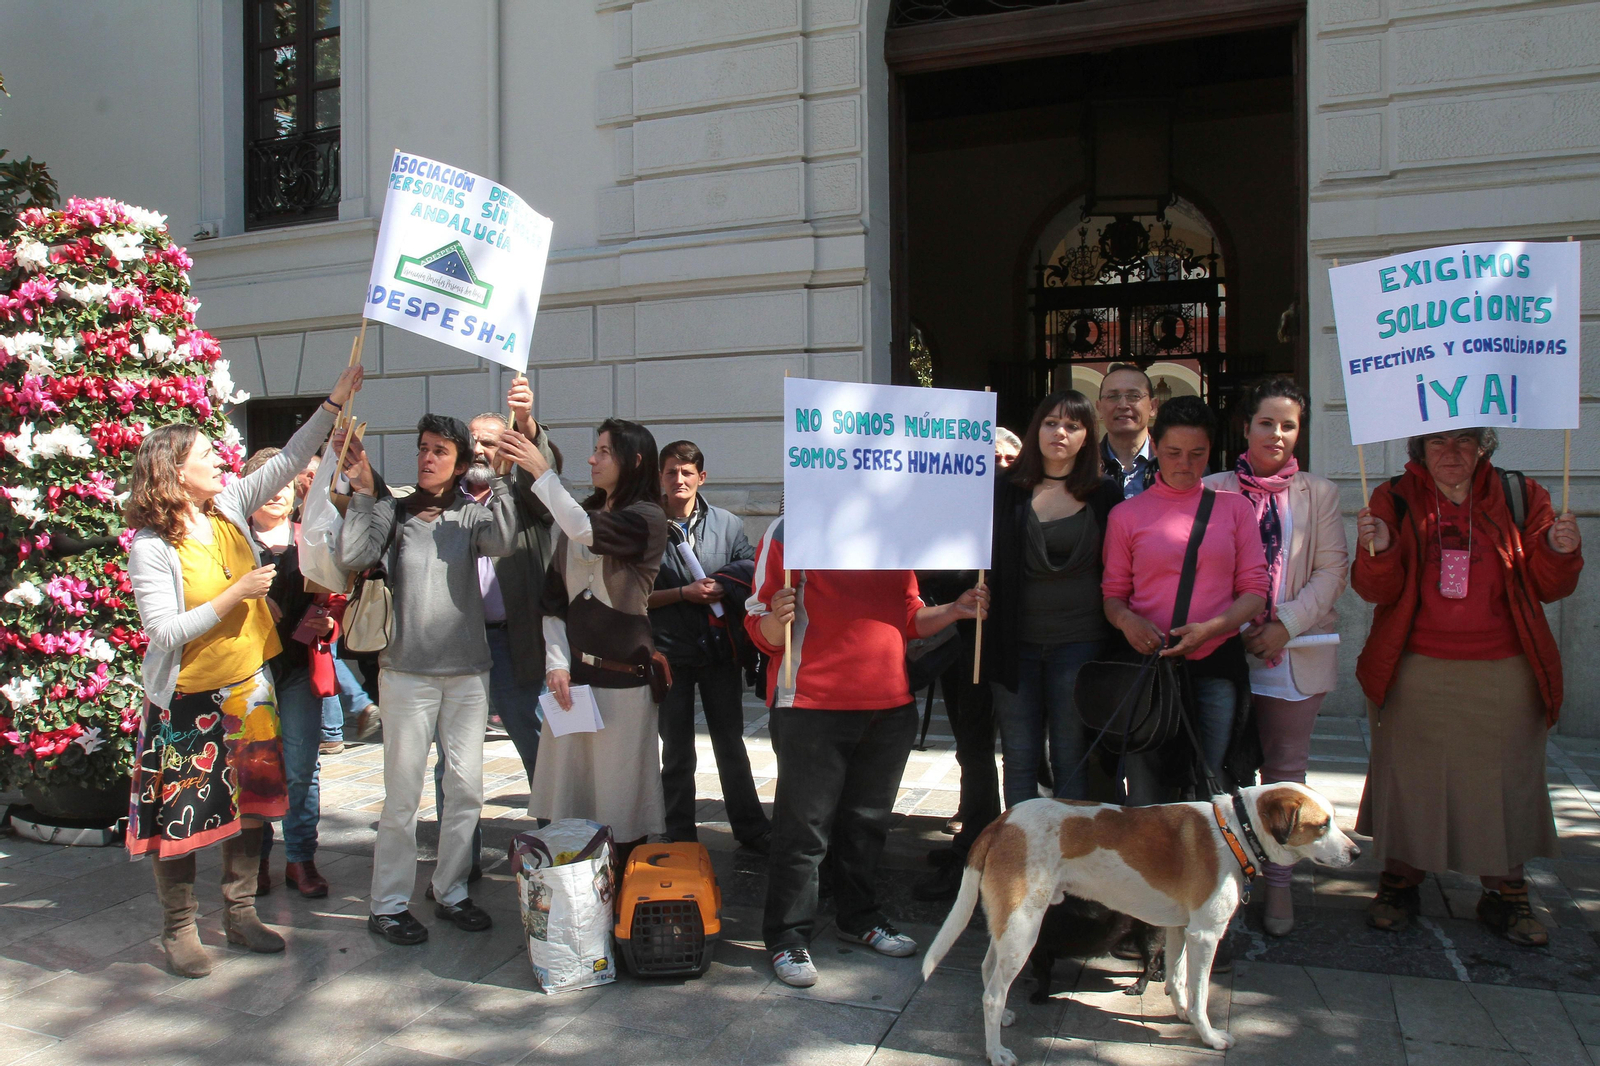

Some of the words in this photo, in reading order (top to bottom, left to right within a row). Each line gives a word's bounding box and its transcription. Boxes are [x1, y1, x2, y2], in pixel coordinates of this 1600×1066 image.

[389, 173, 465, 208] PERSONAS
[481, 202, 510, 226] SIN
[392, 155, 475, 193] ASOCIACIÓN
[489, 186, 540, 229] DERE
[411, 202, 511, 252] ANDALUCÍA
[1376, 290, 1552, 339] SOLUCIONES
[1349, 345, 1436, 375] EFECTIVAS
[1443, 341, 1455, 356] Y
[1462, 335, 1567, 356] CONSOLIDADAS
[1416, 373, 1517, 423] ¡YA!
[795, 408, 822, 432] NO
[832, 410, 895, 436] SOMOS
[904, 411, 994, 445] NÚMEROS,
[788, 446, 848, 470] SOMOS
[853, 448, 903, 473] SERES
[907, 451, 987, 477] HUMANOS
